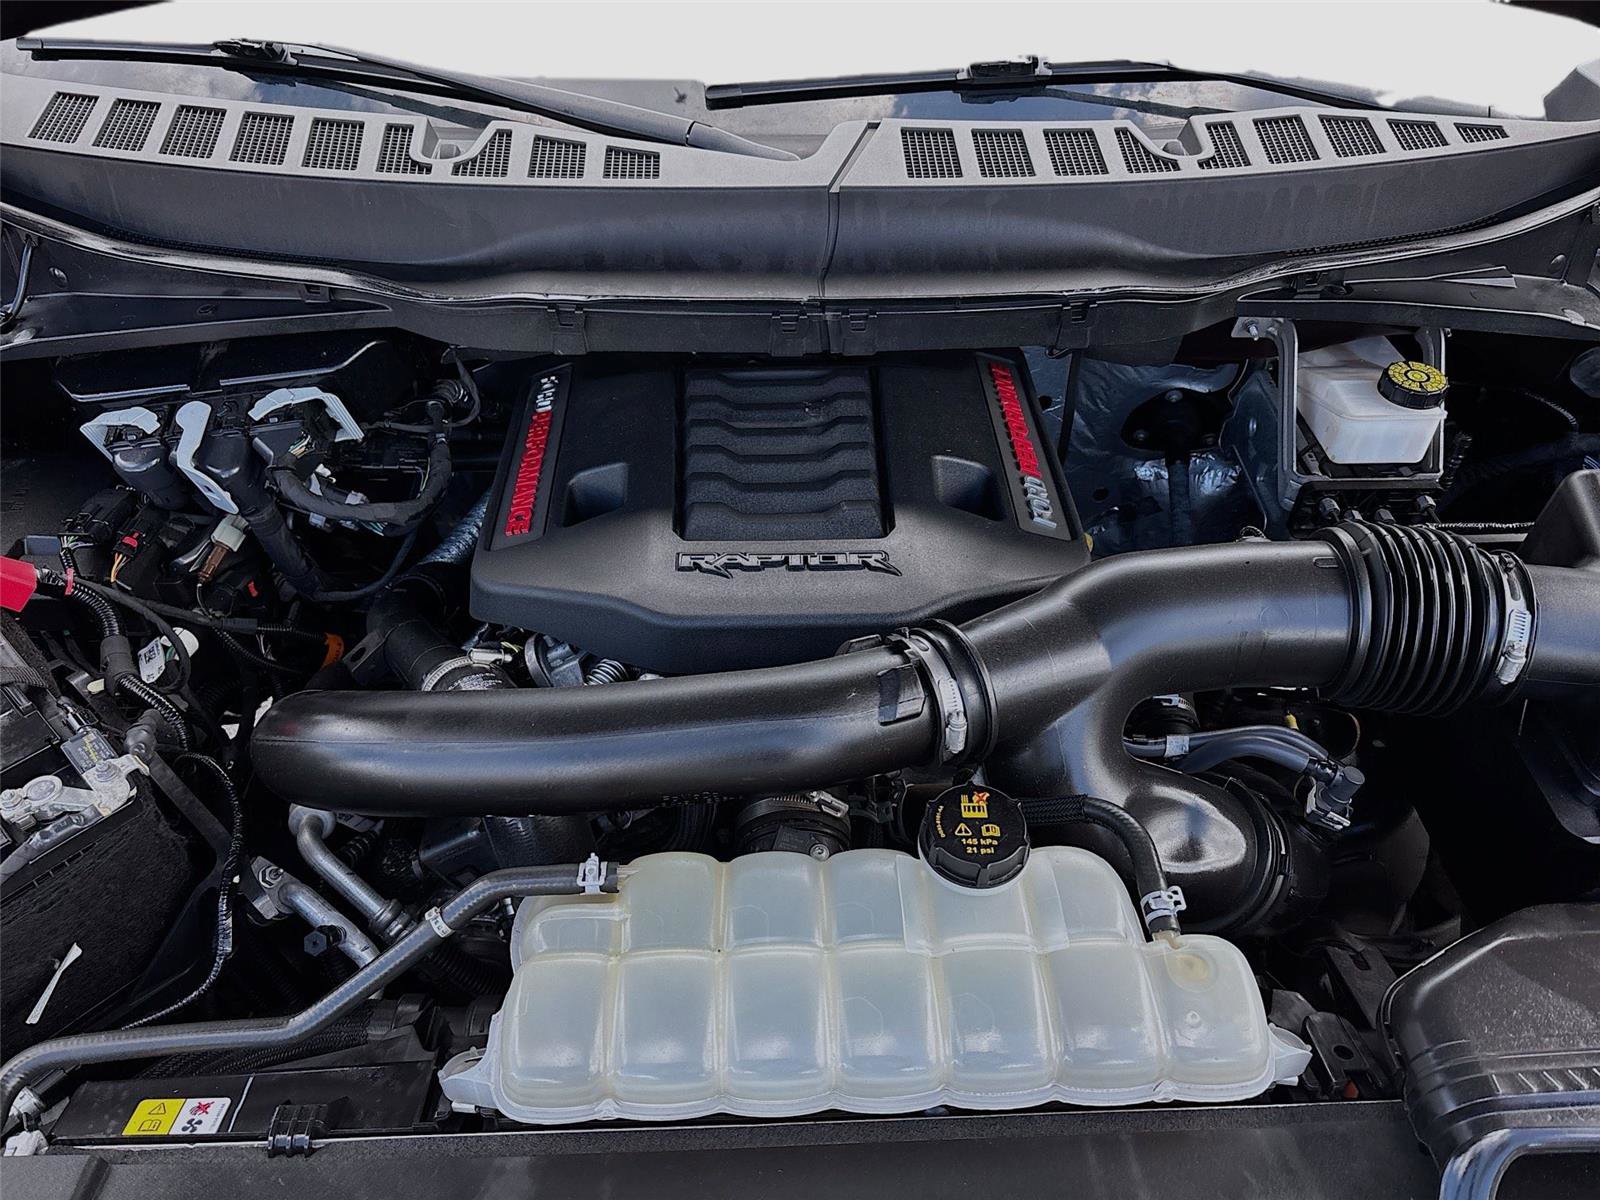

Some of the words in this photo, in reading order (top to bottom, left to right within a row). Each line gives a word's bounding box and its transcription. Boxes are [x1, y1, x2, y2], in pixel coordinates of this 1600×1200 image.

[505, 411, 553, 537] PERFORMANCE
[1023, 474, 1057, 529] FORD
[675, 550, 903, 580] RAPTOR
[961, 838, 979, 846] 145
[980, 838, 999, 846] kPa
[980, 847, 995, 855] psi
